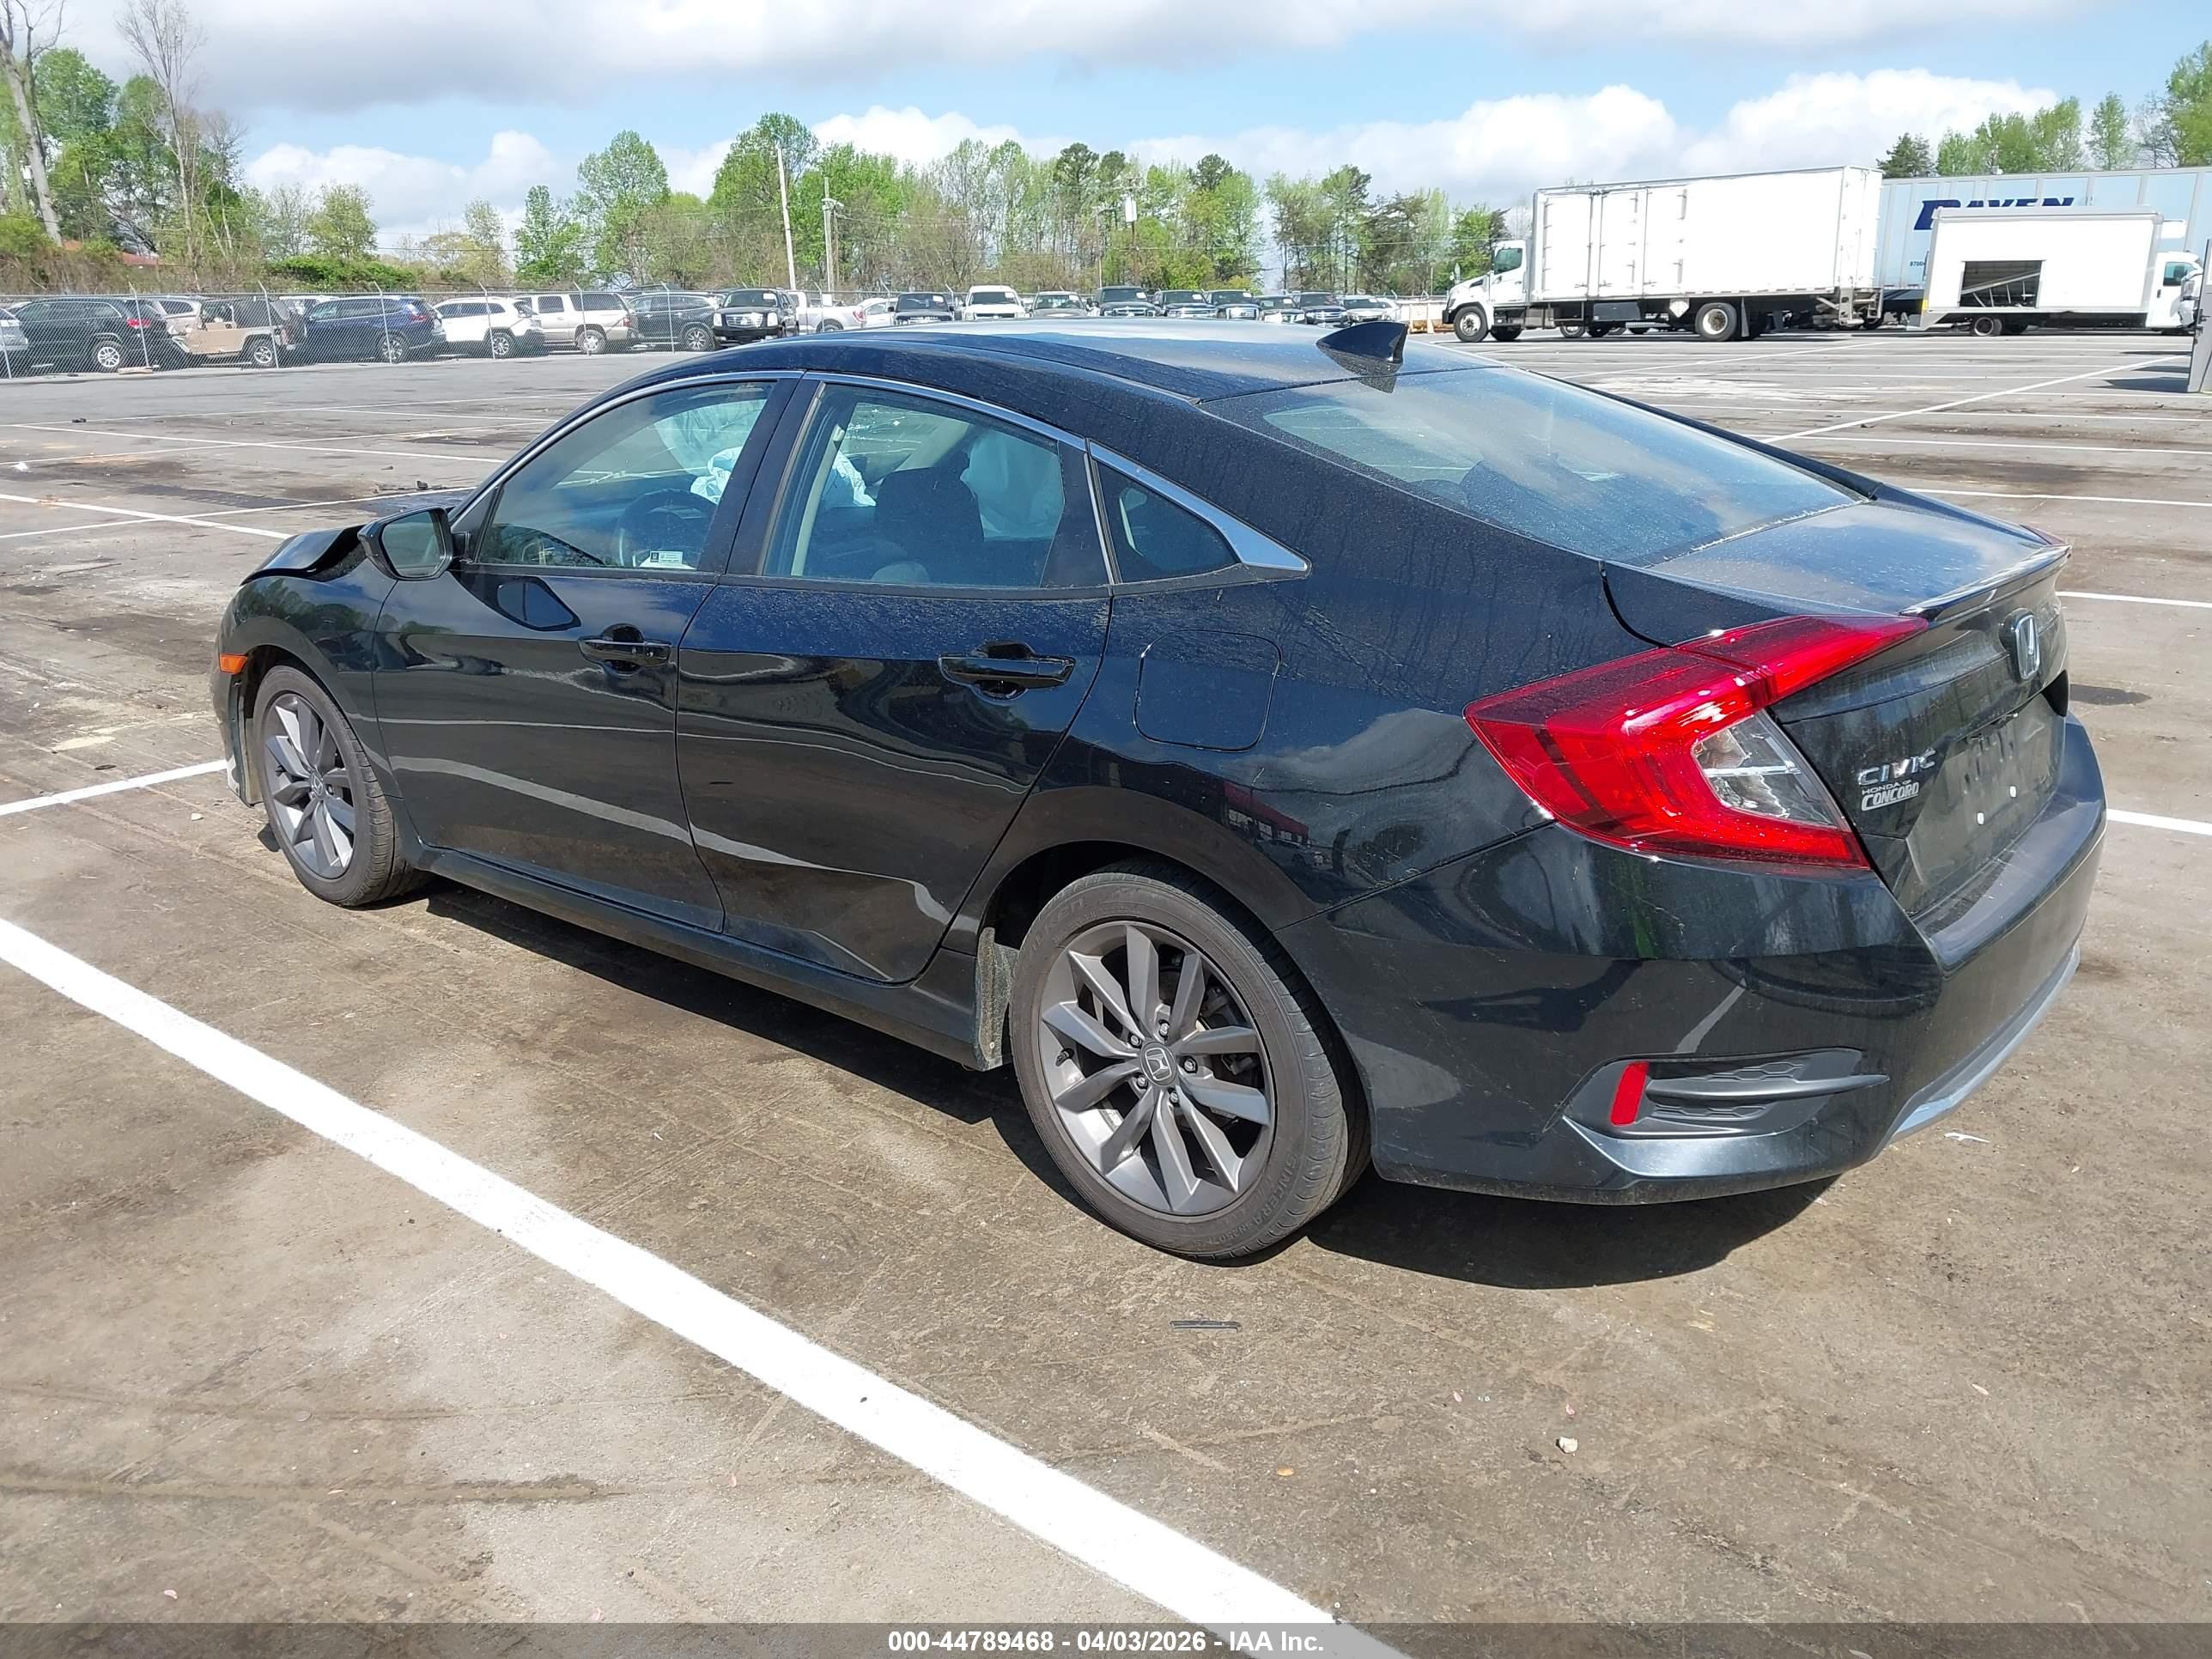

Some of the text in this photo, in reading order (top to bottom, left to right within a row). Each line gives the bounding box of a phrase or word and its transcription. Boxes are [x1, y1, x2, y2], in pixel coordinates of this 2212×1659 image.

[1857, 749, 1936, 786] CIVIC
[1862, 782, 1901, 795] HONDA
[1862, 781, 1920, 811] CONCORD
